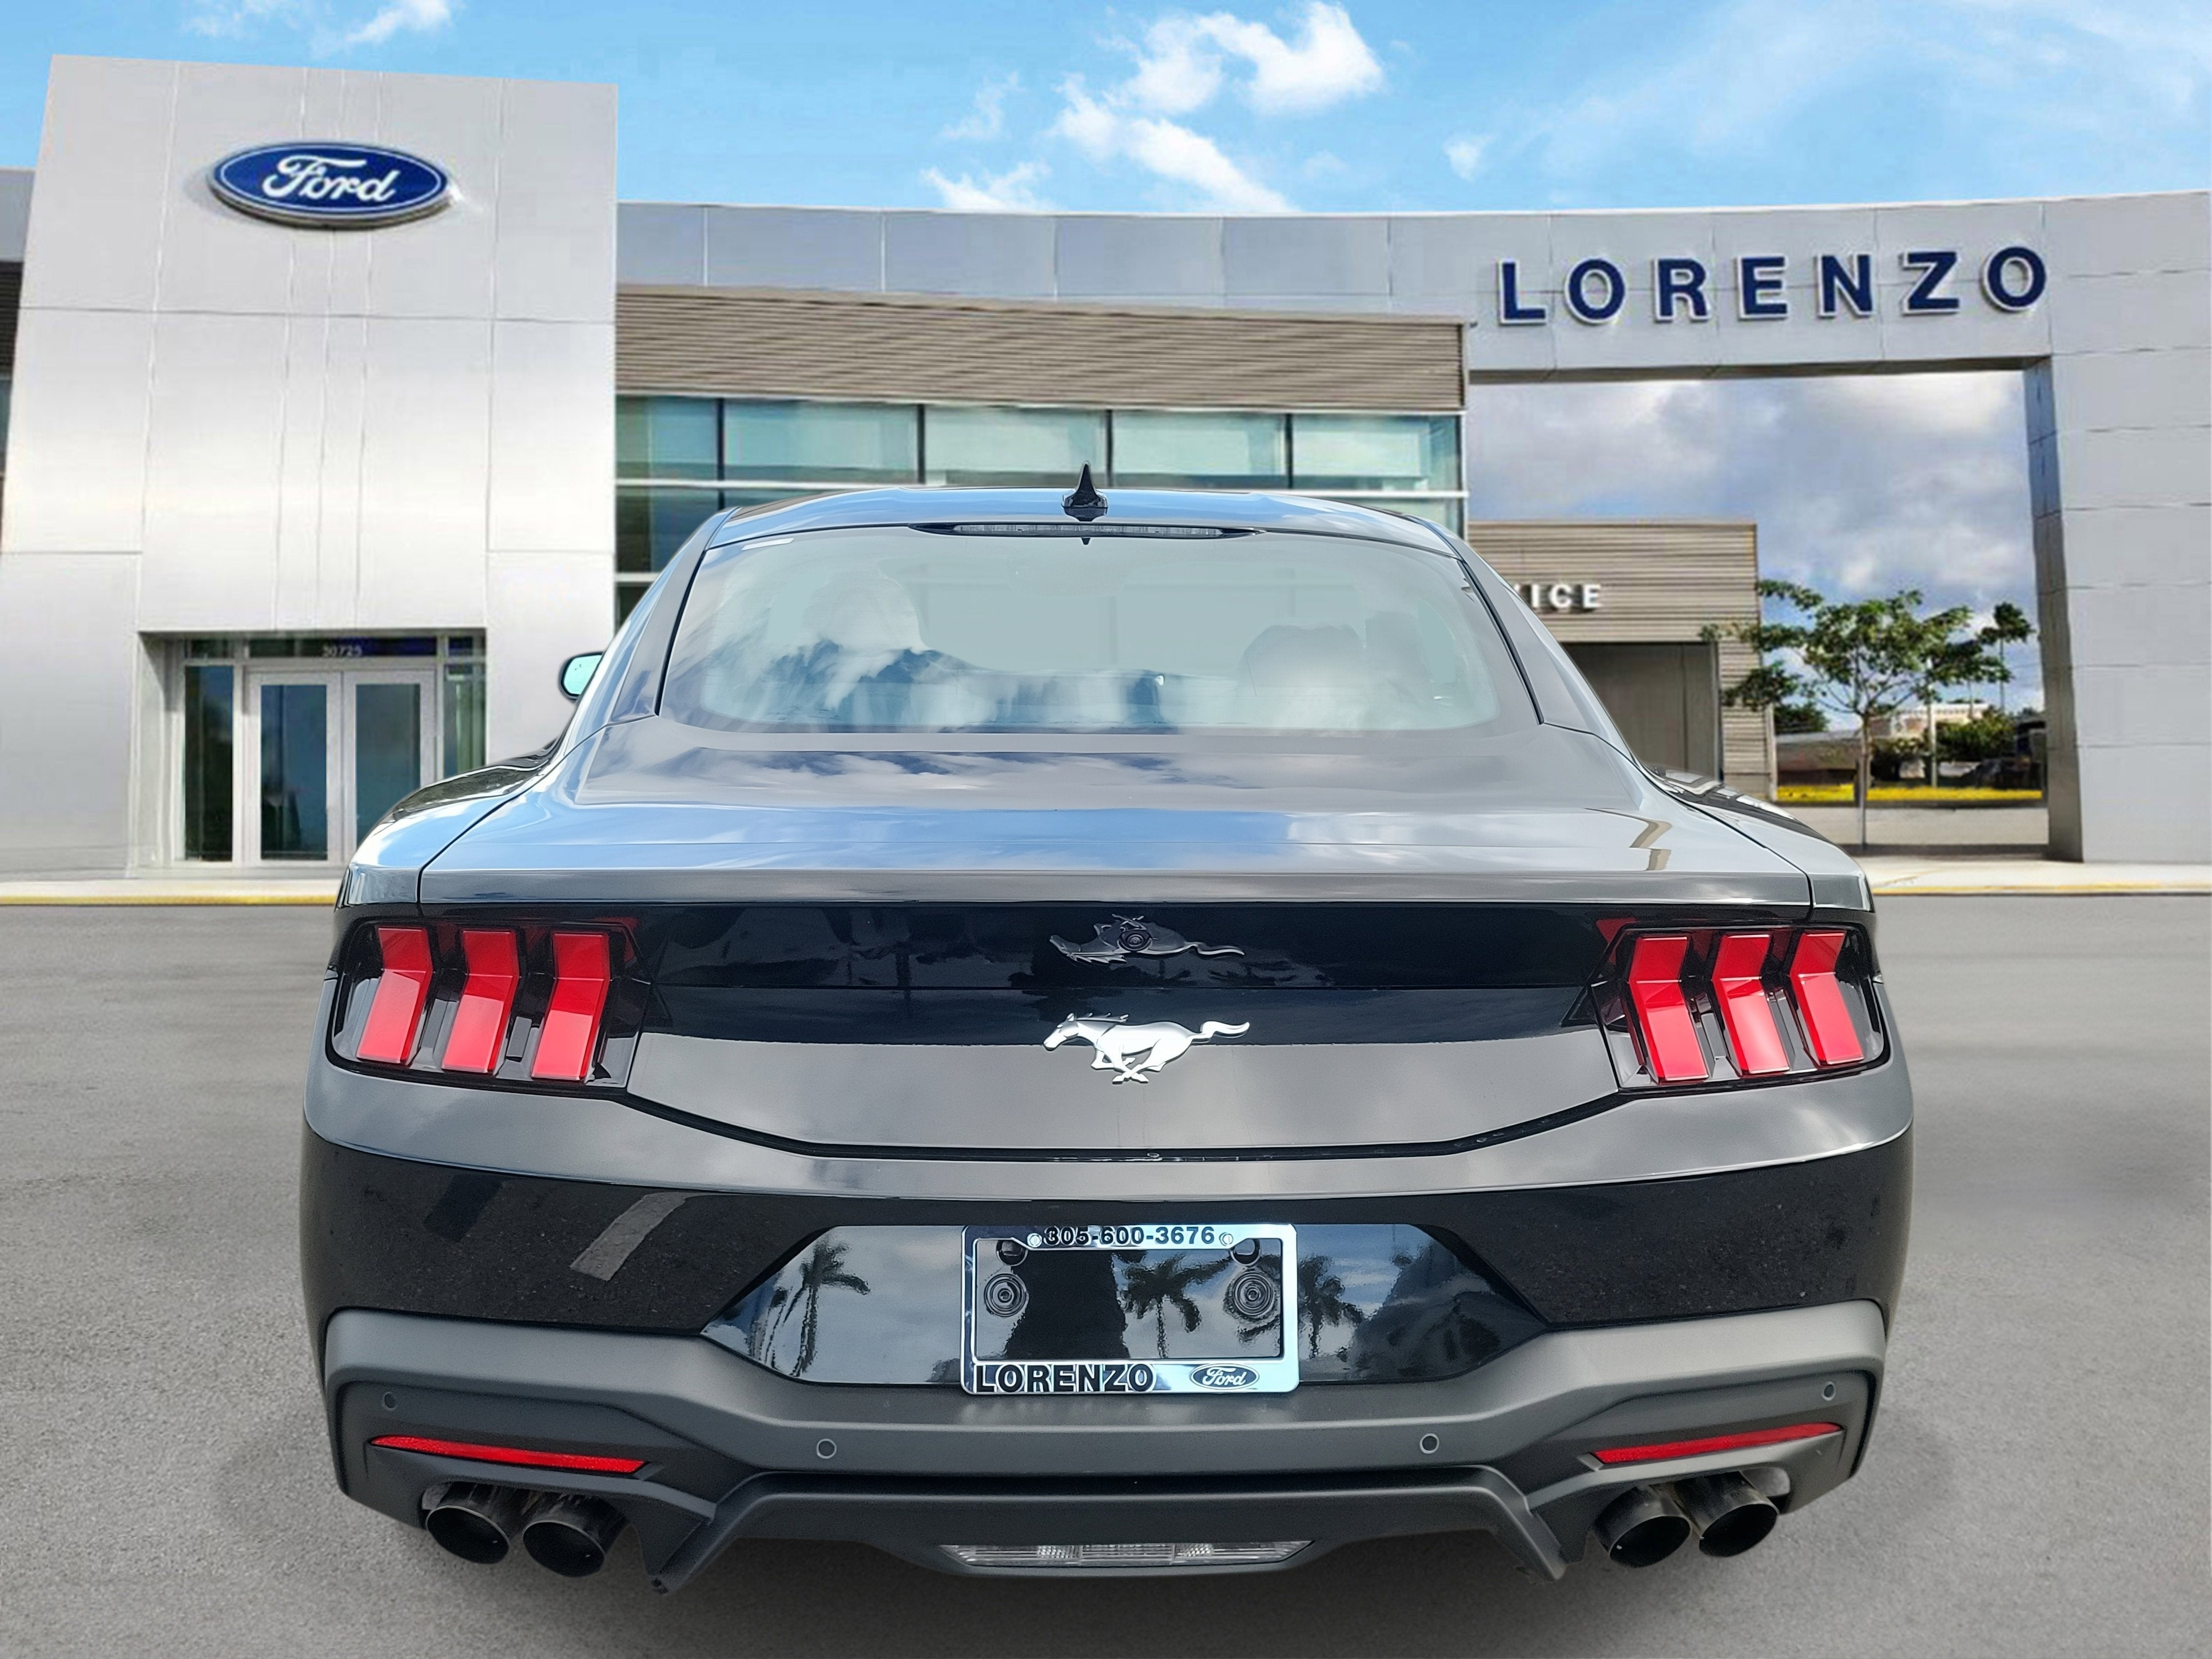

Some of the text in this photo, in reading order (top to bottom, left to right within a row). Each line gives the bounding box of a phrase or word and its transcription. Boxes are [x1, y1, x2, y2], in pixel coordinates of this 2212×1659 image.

[263, 155, 400, 201] Ford
[1498, 246, 2047, 324] LORENZO
[1513, 583, 1603, 608] ICE
[1044, 1226, 1215, 1245] 305-600-3676
[974, 1364, 1156, 1392] LORENZO
[1202, 1367, 1247, 1385] Ford
